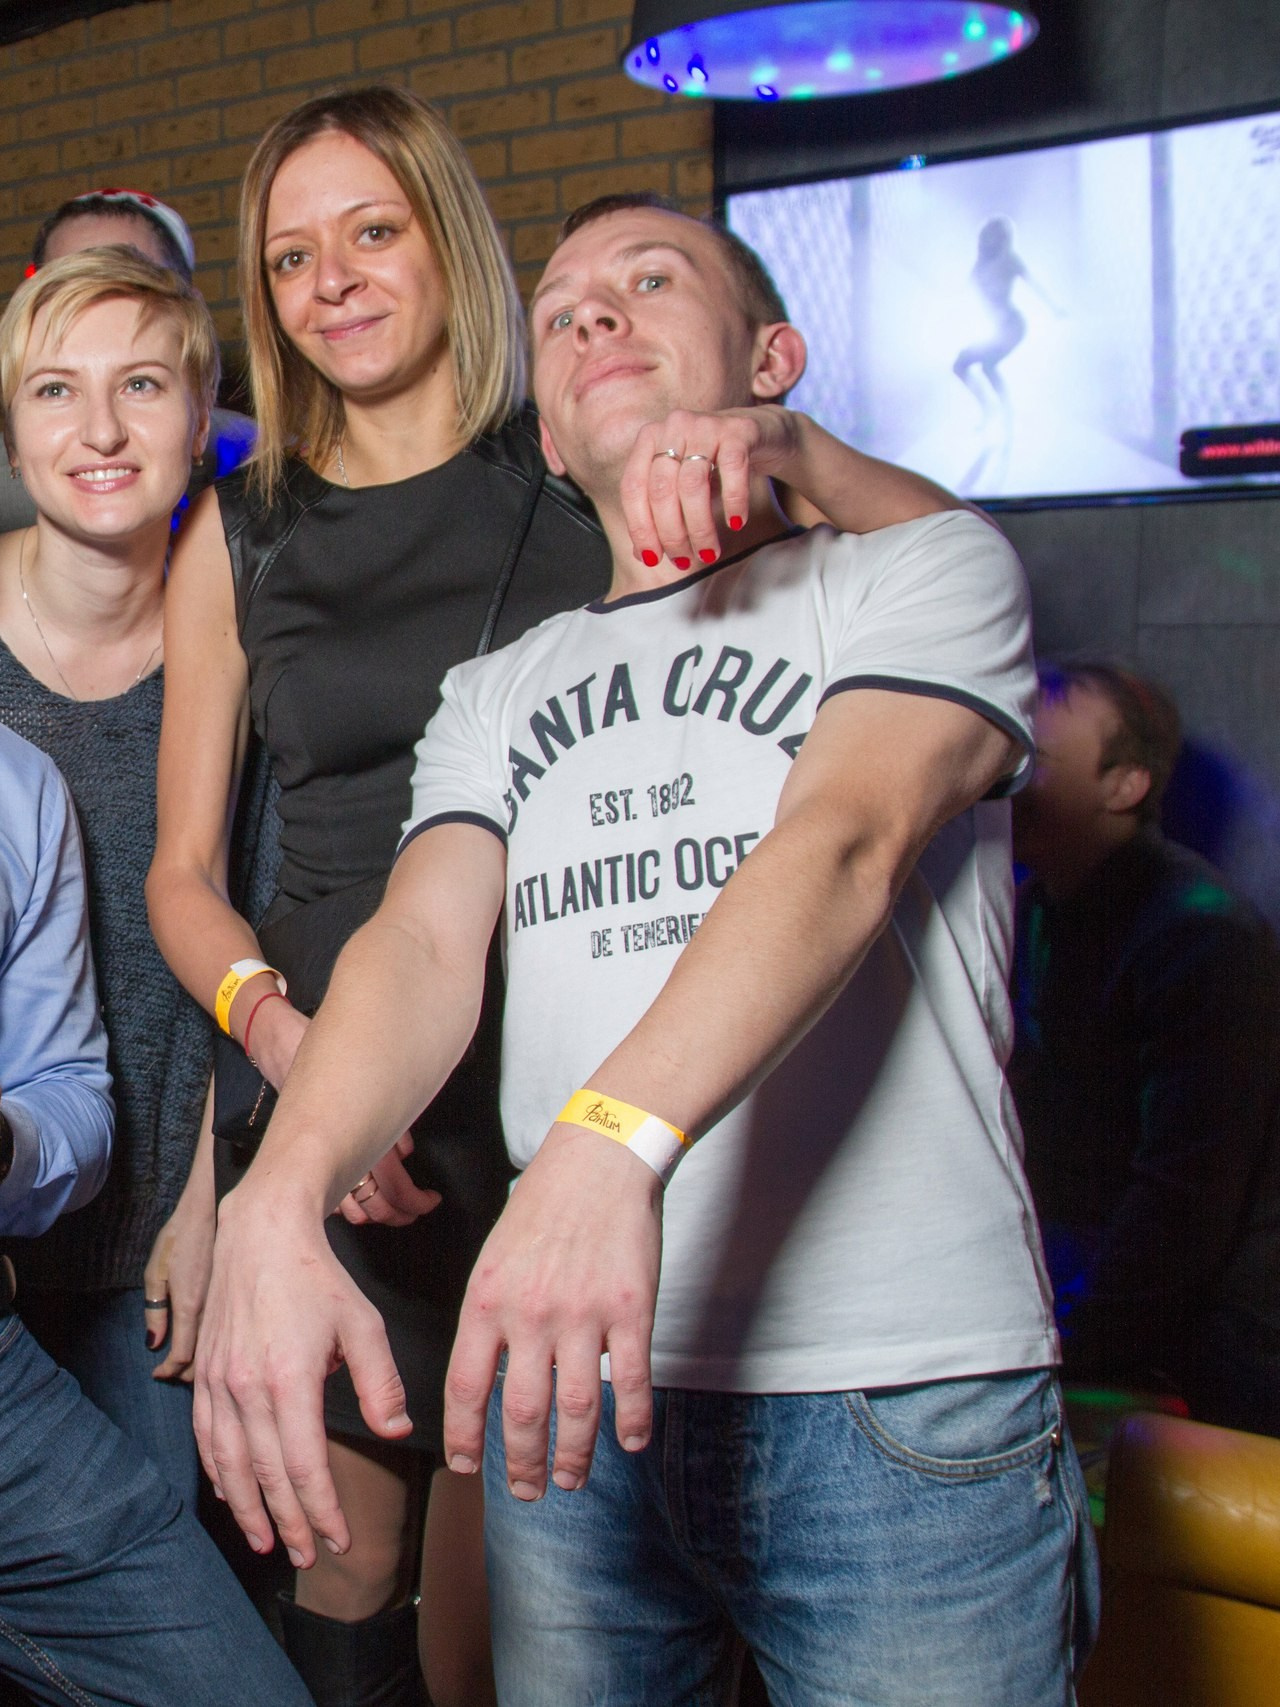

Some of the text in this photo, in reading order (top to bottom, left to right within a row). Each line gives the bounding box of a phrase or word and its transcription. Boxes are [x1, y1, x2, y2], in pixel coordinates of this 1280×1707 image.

[589, 772, 696, 827] EST. 1892
[514, 849, 661, 934] ATLANTIC
[590, 912, 708, 959] DE TENERIF
